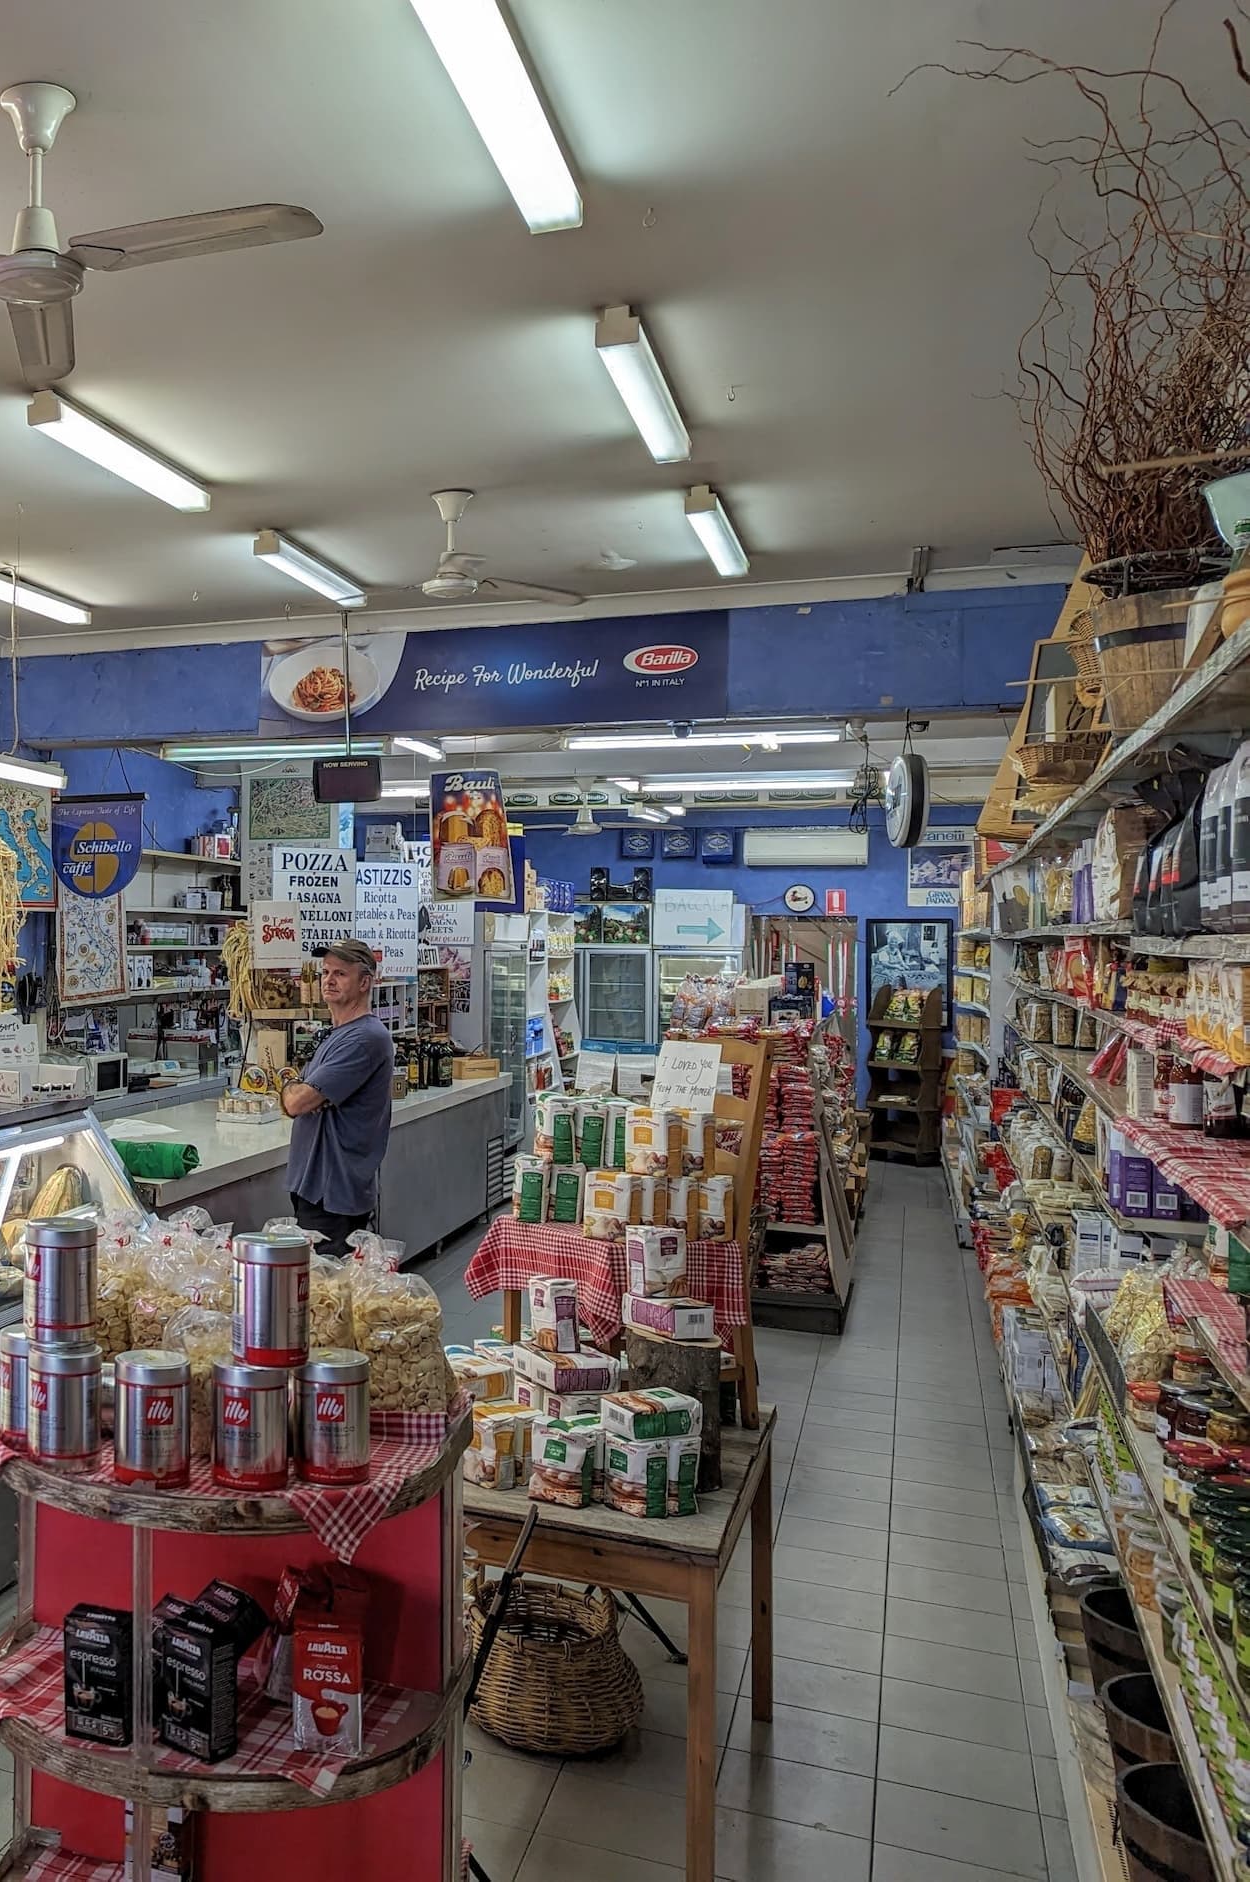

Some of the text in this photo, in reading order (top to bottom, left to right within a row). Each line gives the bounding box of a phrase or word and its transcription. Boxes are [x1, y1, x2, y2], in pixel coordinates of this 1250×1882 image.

[640, 653, 691, 667] Barilla
[414, 659, 599, 693] Recipe For Wonderful
[662, 678, 685, 687] ITALY
[340, 760, 369, 768] SERVING
[444, 774, 496, 792] Bauli
[123, 805, 137, 815] Life
[77, 840, 132, 854] Schibello
[281, 852, 349, 872] POZZA
[290, 875, 339, 887] FROZEN
[356, 868, 412, 886] ASTIZZIS
[364, 890, 397, 904] Ricotta
[300, 910, 352, 922] NELLONI
[355, 907, 416, 921] getables & Peas
[301, 928, 352, 940] ETARIAN
[357, 926, 416, 939] nach & Ricotta
[384, 946, 404, 957] Peas
[662, 1057, 668, 1067] I
[671, 1057, 698, 1071] LOVED
[675, 1085, 687, 1094] THE
[147, 1400, 173, 1424] illy
[224, 1400, 249, 1425] illy
[318, 1398, 344, 1422] illy
[76, 1629, 111, 1644] LAVAZZA
[171, 1636, 202, 1657] LAVAZZA
[307, 1641, 348, 1655] LAVAZZA
[70, 1649, 117, 1668] espresso
[166, 1656, 206, 1682] espresso
[303, 1669, 351, 1684] ROSSA
